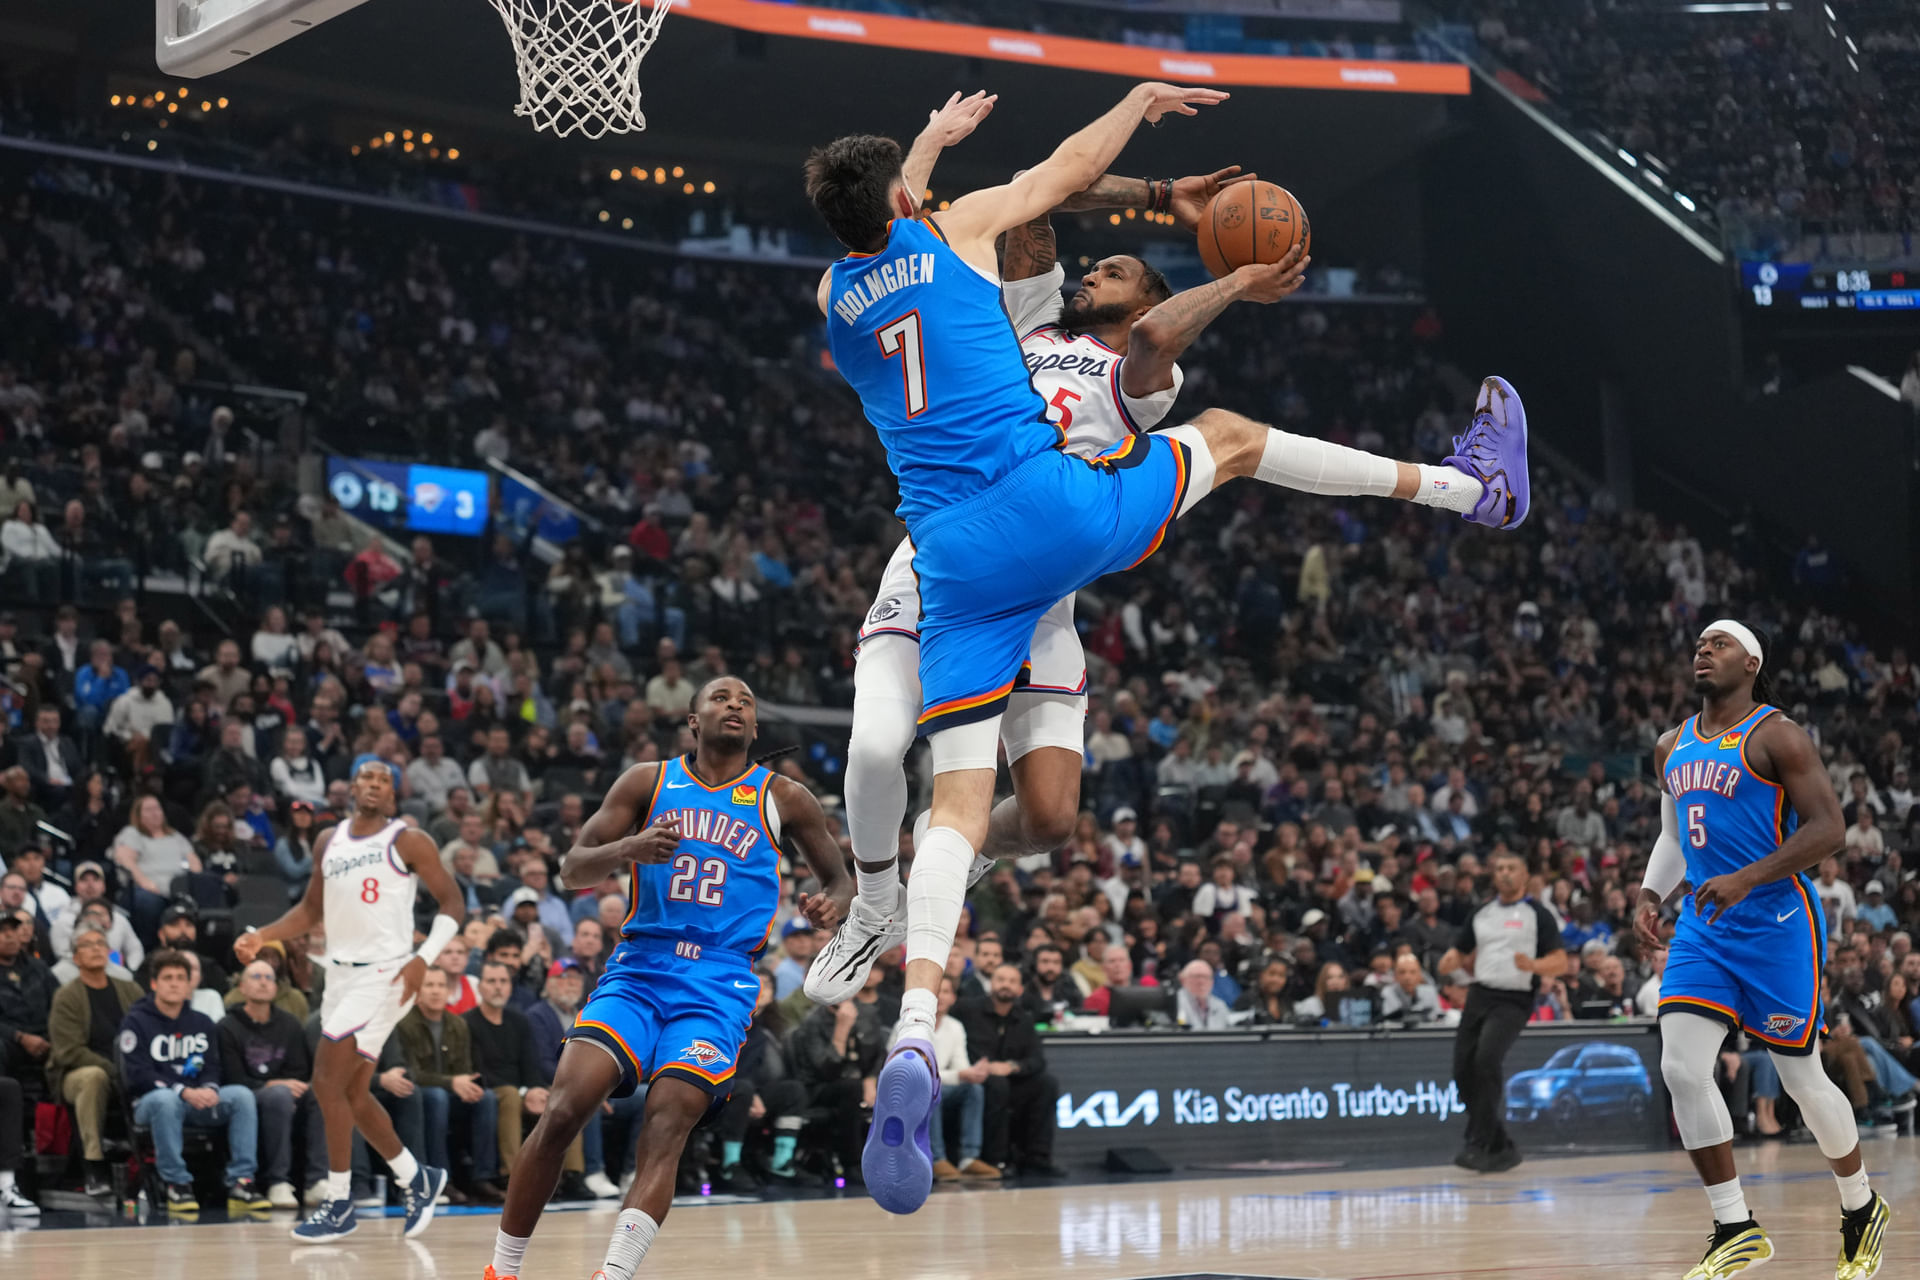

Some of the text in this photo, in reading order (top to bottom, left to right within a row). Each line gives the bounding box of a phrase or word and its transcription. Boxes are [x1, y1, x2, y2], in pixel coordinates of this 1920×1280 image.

[833, 253, 935, 327] HOLMGREN
[874, 308, 928, 420] 7
[1050, 387, 1082, 431] 5
[455, 490, 475, 519] 3
[1667, 760, 1742, 801] THUNDER
[1688, 803, 1707, 849] 5
[360, 877, 380, 904] 8
[668, 853, 727, 907] 22
[676, 941, 701, 960] OKC
[150, 1032, 209, 1062] Clips
[1056, 1090, 1158, 1128] KIA
[1173, 1088, 1219, 1124] Kia
[1224, 1087, 1329, 1123] Sorento
